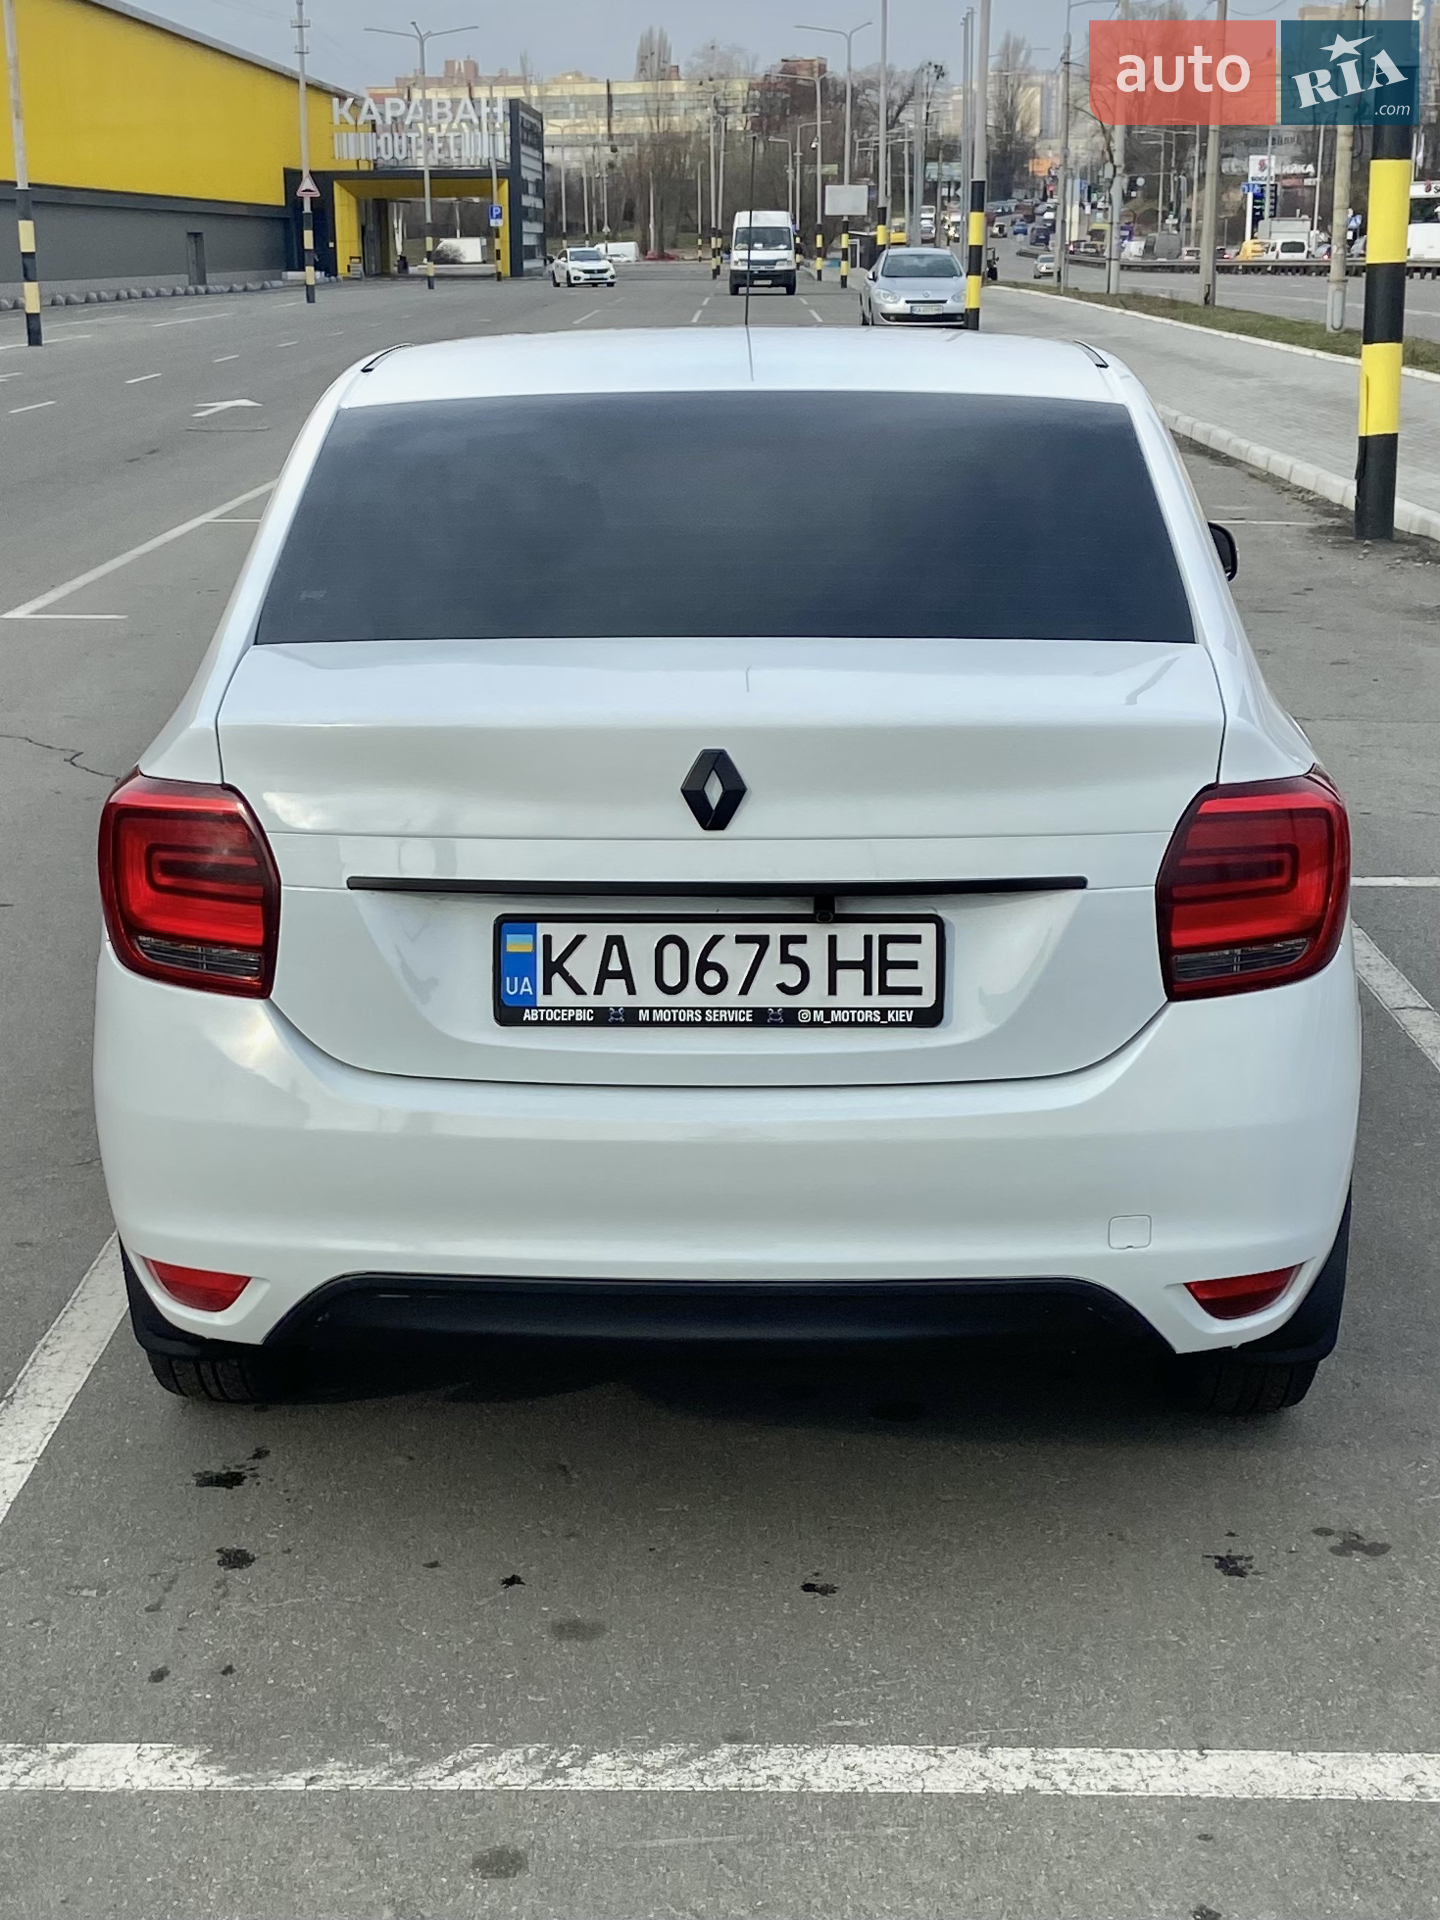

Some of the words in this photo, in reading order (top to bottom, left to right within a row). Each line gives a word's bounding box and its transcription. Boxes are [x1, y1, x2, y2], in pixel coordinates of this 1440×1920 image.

[332, 97, 505, 127] КАРАВАН
[379, 132, 460, 161] OUTET
[493, 206, 501, 219] P
[542, 934, 637, 996] KA
[654, 934, 811, 996] 0675
[827, 934, 923, 996] HE
[506, 977, 533, 996] UA
[522, 1008, 594, 1022] АВТОСЕРВІС
[638, 1009, 650, 1022] M
[652, 1009, 702, 1022] MOTORS
[705, 1009, 753, 1022] SERVICE
[813, 1009, 914, 1024] M_MOTORS_KIEV
